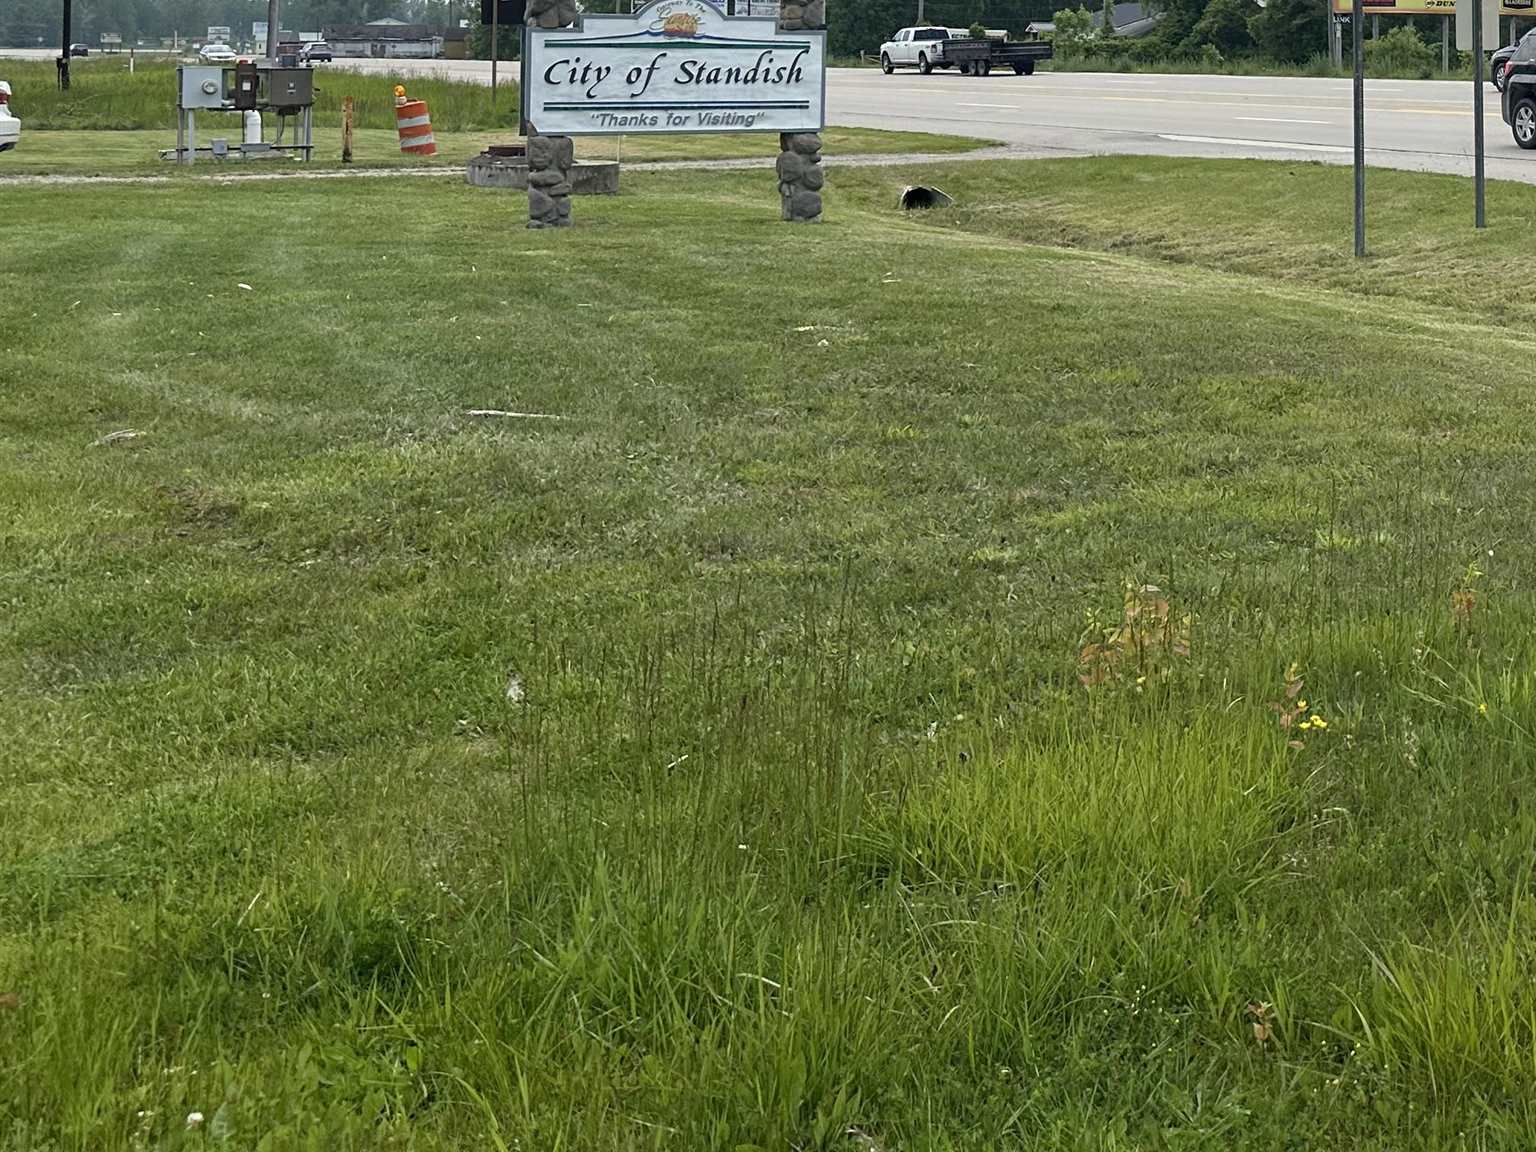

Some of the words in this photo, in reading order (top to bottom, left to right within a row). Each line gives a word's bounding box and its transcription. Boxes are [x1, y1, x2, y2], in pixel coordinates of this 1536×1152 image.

[544, 57, 611, 99] City
[626, 52, 667, 98] of
[674, 49, 810, 85] Standish
[665, 112, 690, 126] for
